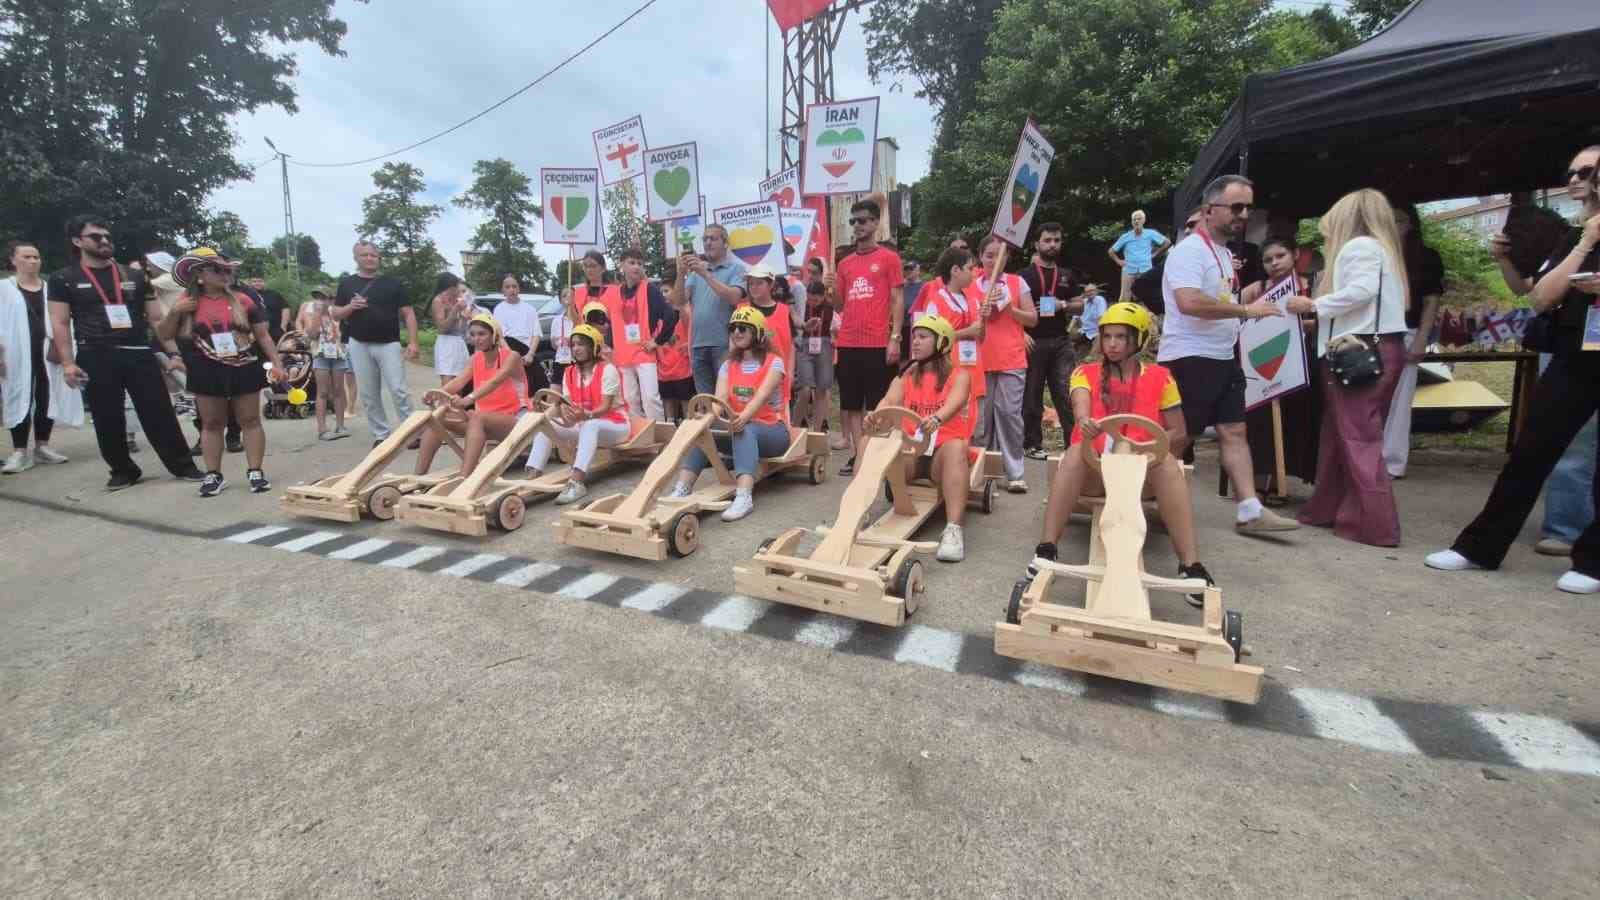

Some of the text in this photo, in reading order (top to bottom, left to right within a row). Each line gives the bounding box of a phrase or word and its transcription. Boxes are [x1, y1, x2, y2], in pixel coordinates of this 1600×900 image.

[825, 106, 860, 122] İRAN
[650, 148, 690, 164] ADYGEA
[544, 173, 594, 184] ÇEÇENİSTAN
[720, 205, 772, 220] KOLOMBİYA
